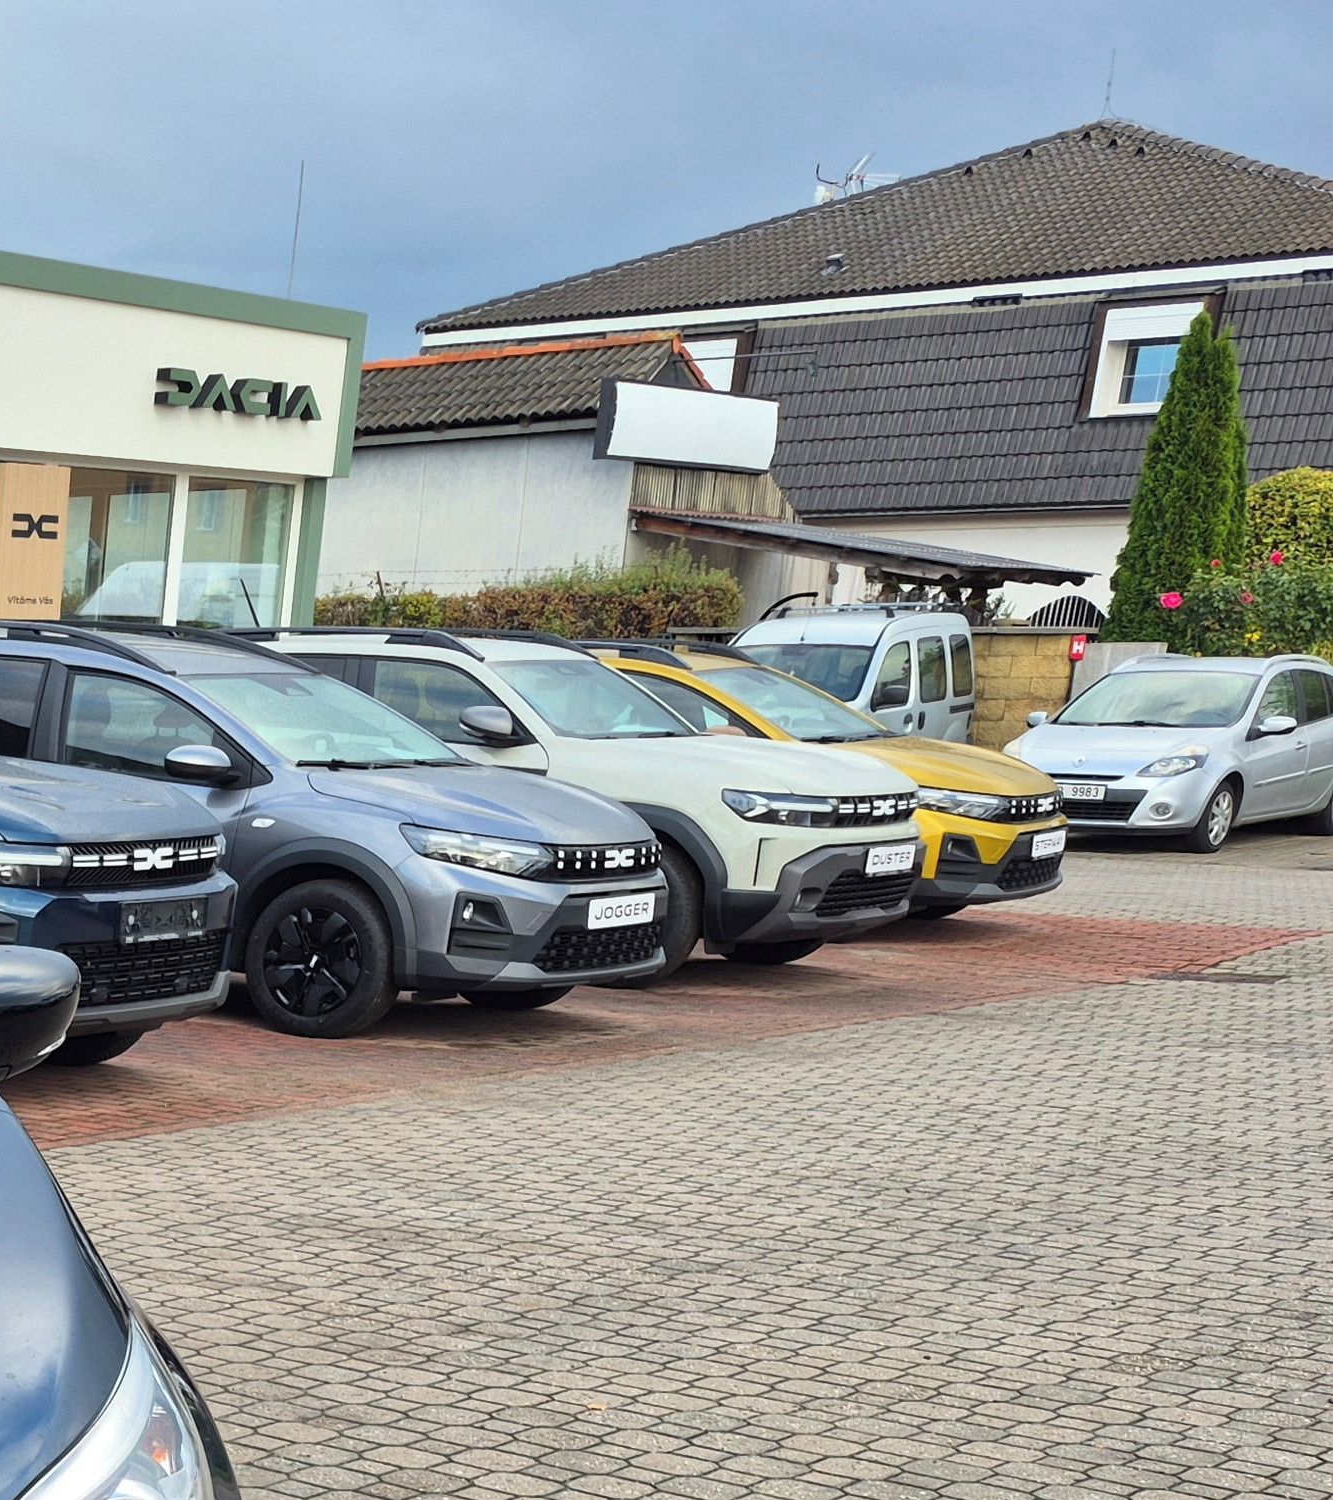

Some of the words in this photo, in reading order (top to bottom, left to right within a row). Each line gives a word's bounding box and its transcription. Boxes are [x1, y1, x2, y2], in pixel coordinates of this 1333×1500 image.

[154, 367, 322, 421] DACIA
[7, 596, 38, 605] Vítáme
[1072, 641, 1085, 654] H
[1071, 786, 1100, 798] 9983
[872, 851, 911, 865] DUSTER
[594, 902, 650, 920] JOGGER
